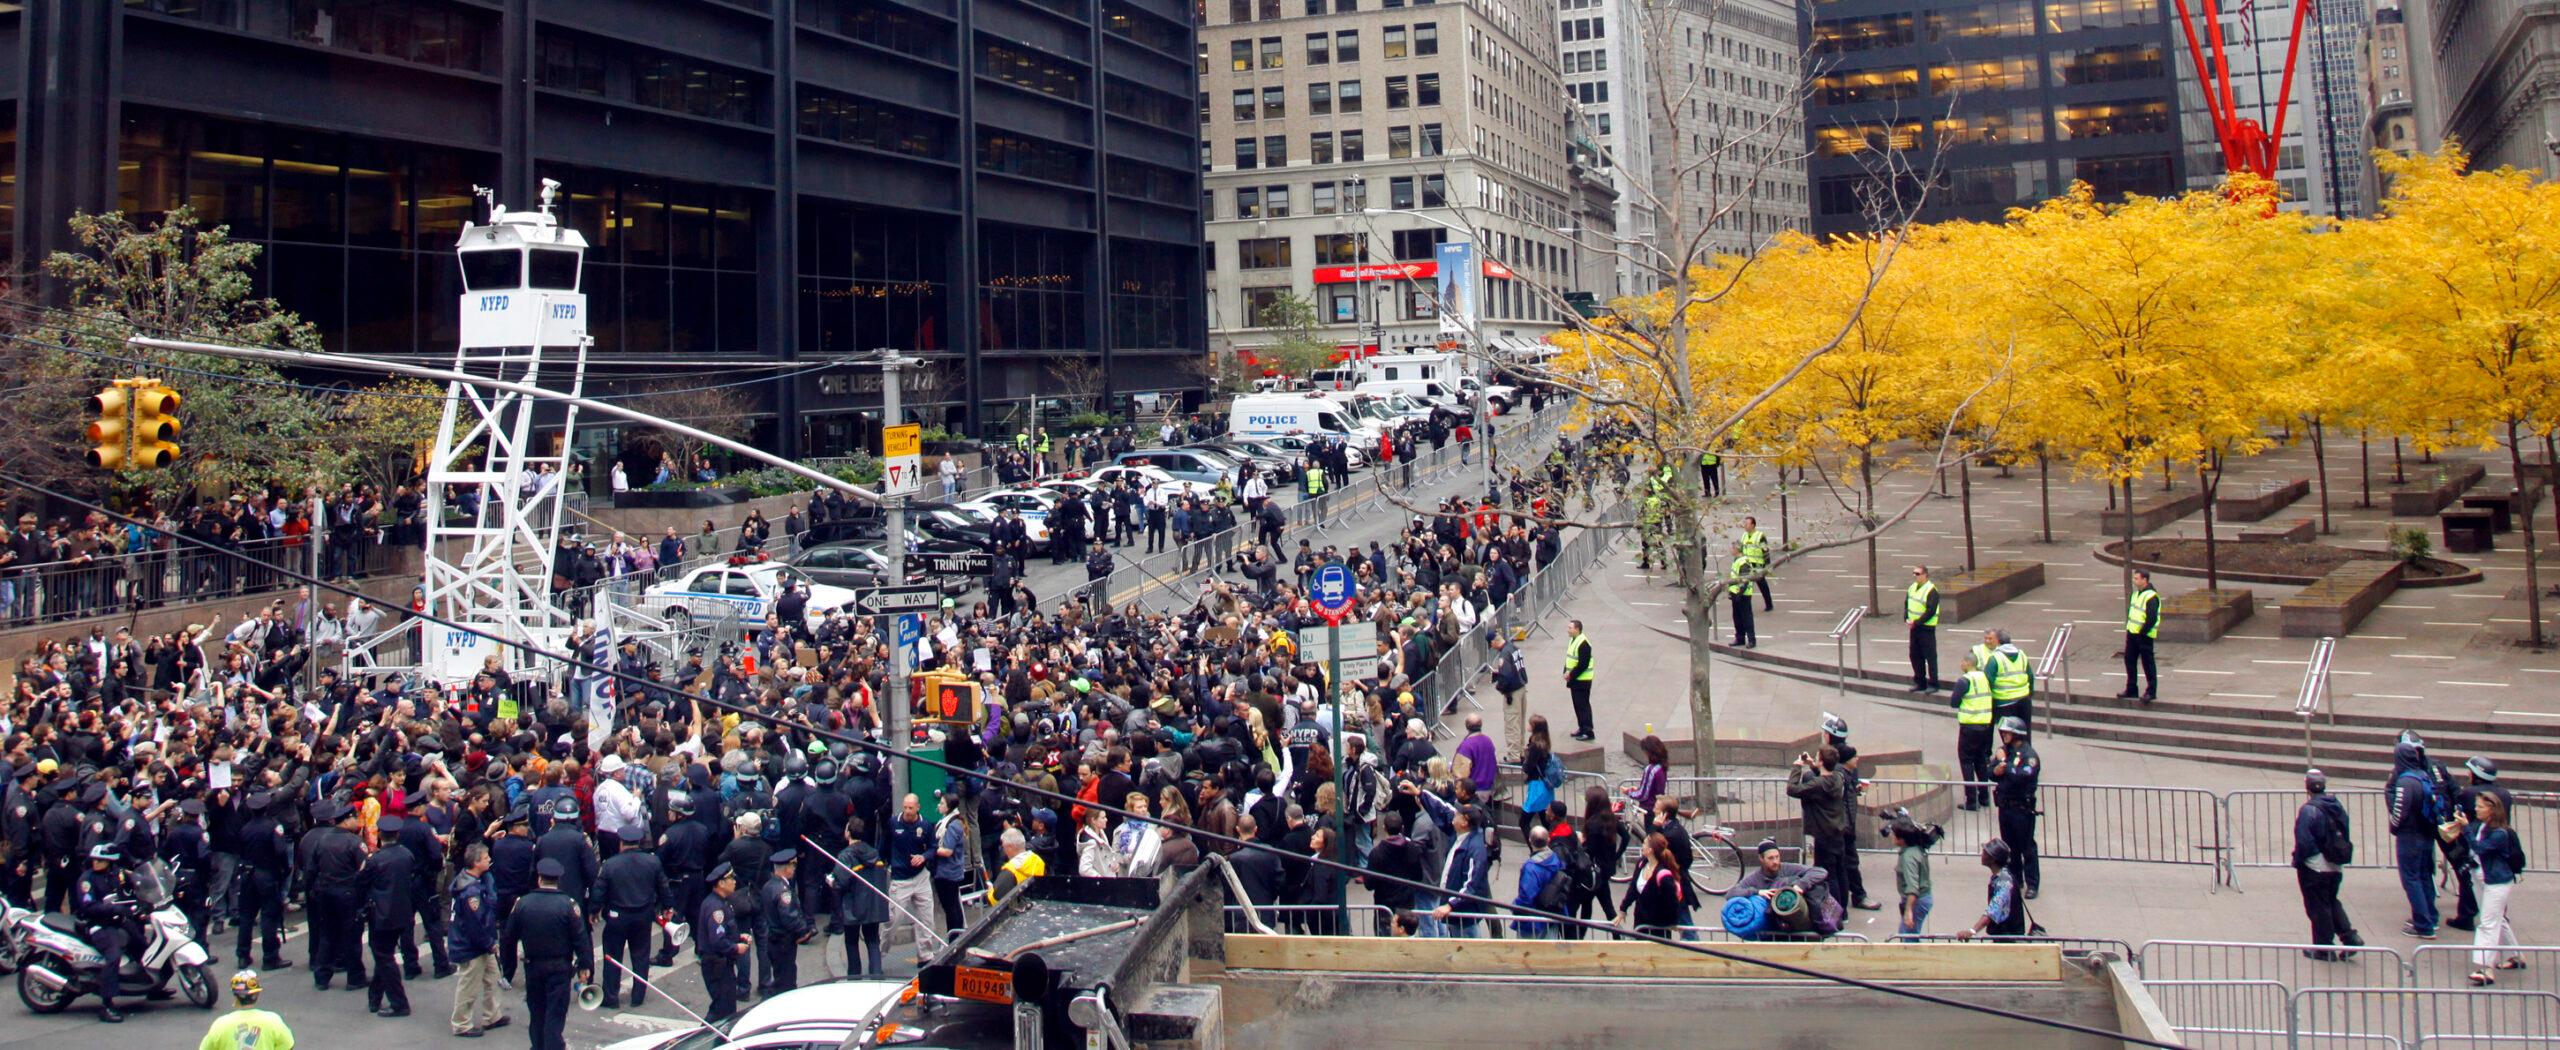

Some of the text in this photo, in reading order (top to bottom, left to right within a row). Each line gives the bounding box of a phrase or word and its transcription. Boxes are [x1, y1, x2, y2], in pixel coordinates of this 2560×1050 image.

[1444, 245, 1462, 253] NYC
[480, 295, 509, 312] NYPD
[552, 303, 576, 319] NYPD
[819, 374, 847, 394] ONE
[1248, 415, 1298, 425] POLICE
[886, 430, 908, 440] TURNING
[886, 442, 908, 452] VEHICLES
[901, 471, 908, 480] TO
[933, 558, 988, 571] TRINITY PLACE
[866, 593, 927, 608] ONE WAY
[446, 631, 477, 648] NYPD
[1302, 634, 1314, 644] NJ
[1302, 650, 1314, 660] PA
[1290, 728, 1318, 737] NYPD
